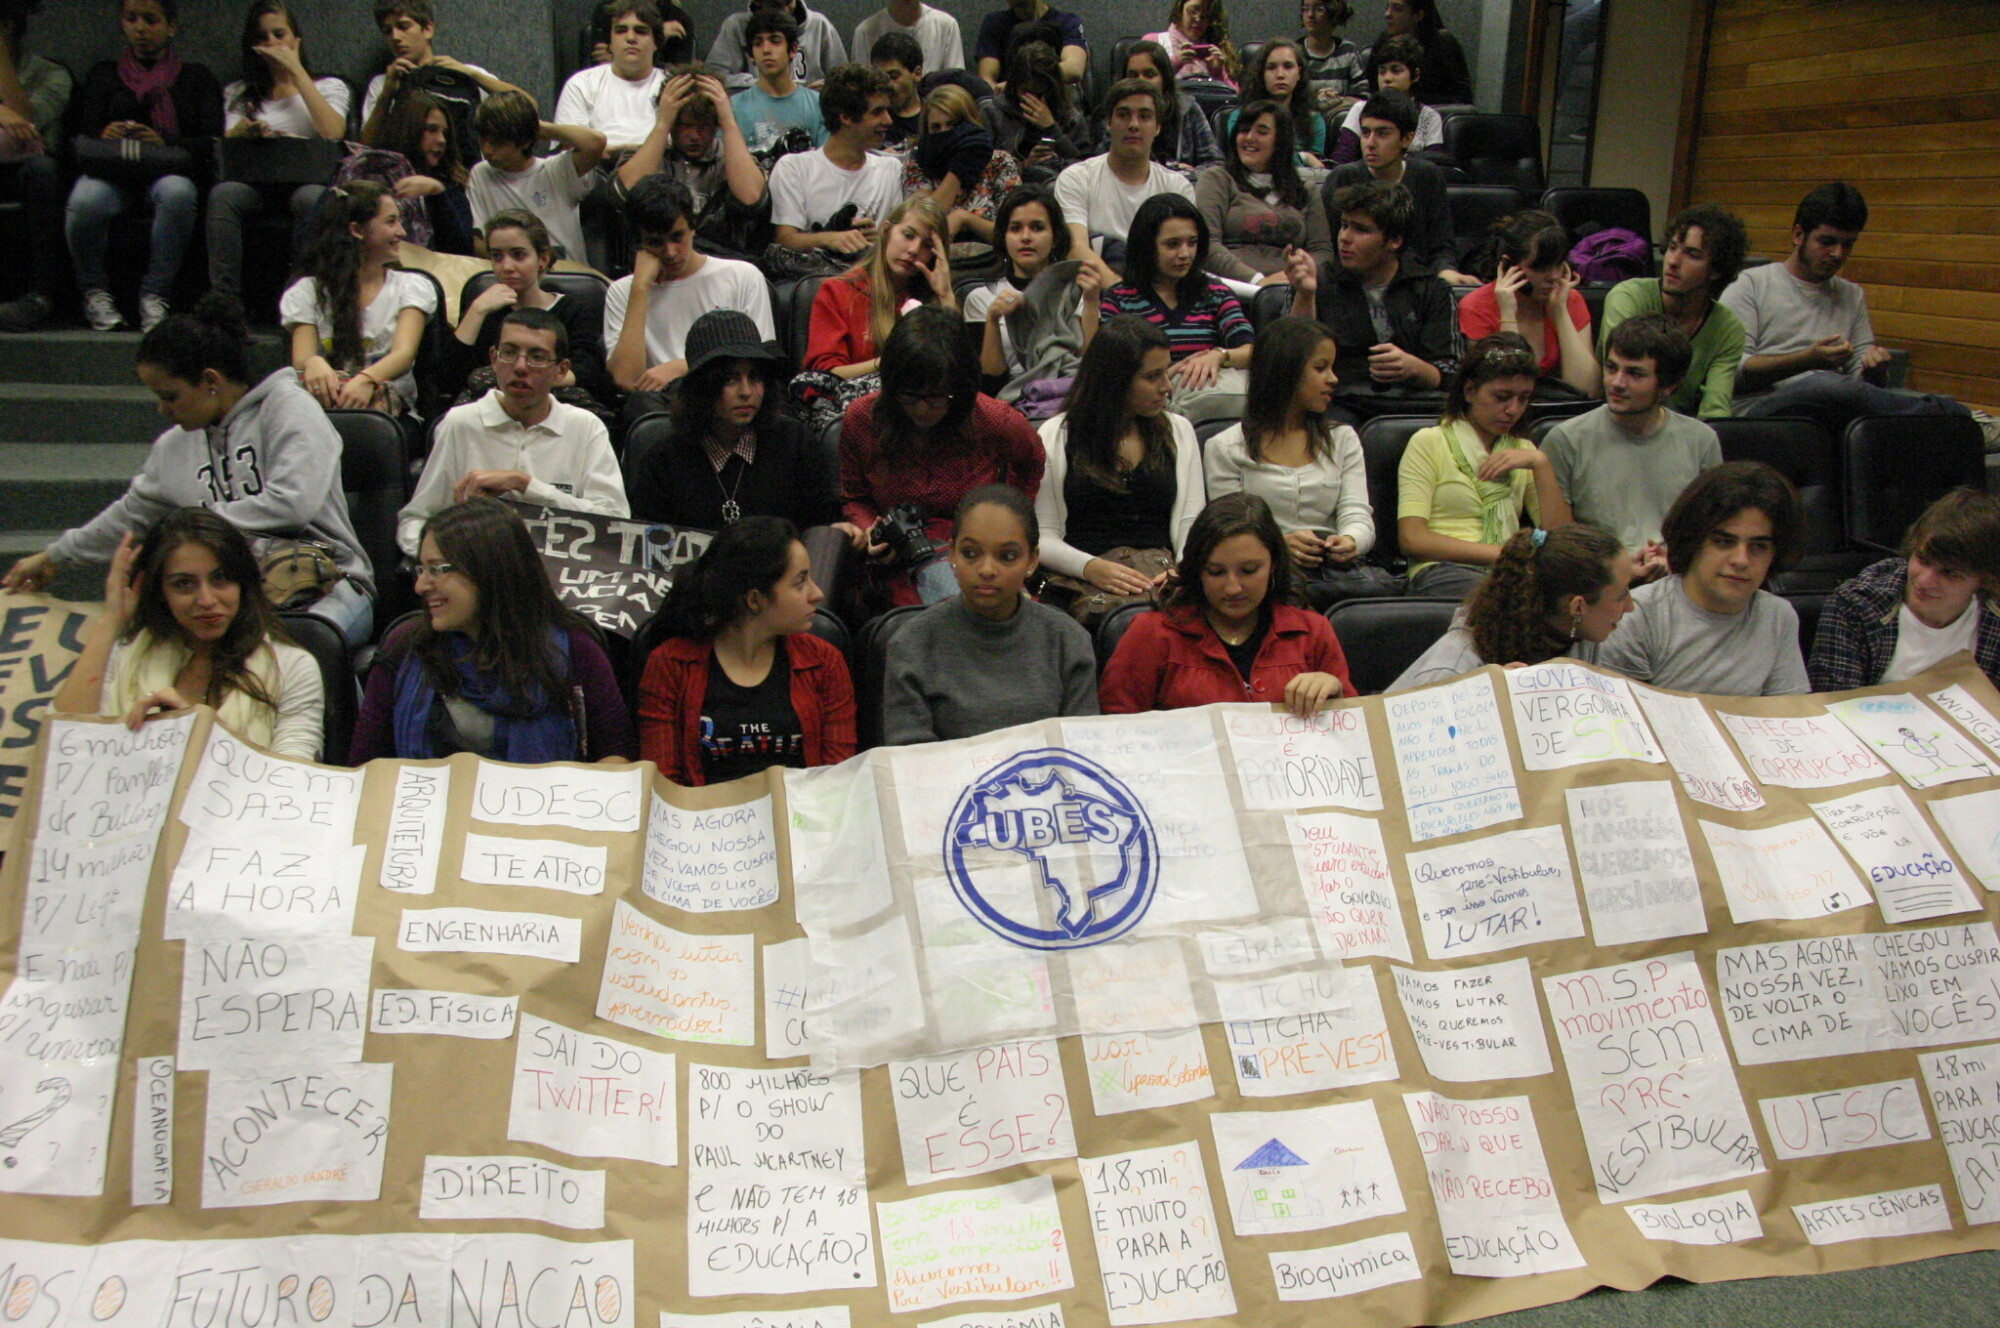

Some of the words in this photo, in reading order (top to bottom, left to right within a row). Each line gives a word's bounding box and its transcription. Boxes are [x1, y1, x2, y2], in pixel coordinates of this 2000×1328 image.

[1518, 668, 1615, 693] GOVERNO
[1520, 694, 1632, 722] VERGONHA
[740, 723, 770, 734] THE
[1725, 716, 1827, 736] CHEGA
[60, 729, 77, 755] 6
[1531, 731, 1566, 755] DE
[1770, 739, 1802, 753] DE
[210, 739, 355, 794] QUEM
[201, 780, 335, 827] SABE
[479, 782, 636, 823] UDESC
[386, 771, 436, 890] ARQUITETURA
[693, 808, 757, 832] AGORA
[985, 801, 1119, 851] UBES
[712, 830, 766, 852] NOSSA
[206, 848, 310, 878] FAZ
[481, 852, 601, 887] TEATRO
[678, 862, 728, 876] VAMOS
[1415, 858, 1494, 883] Queremos
[1871, 853, 1953, 883] EDUCAÇÃO
[175, 881, 195, 911] A
[221, 882, 341, 913] HORA
[664, 877, 701, 893] VOLTA
[711, 880, 720, 891] O
[702, 898, 724, 909] DE
[203, 937, 287, 987] NÃO
[1724, 946, 1788, 977] MAS
[1797, 937, 1858, 968] AGORA
[1872, 929, 1950, 957] CHEGOU
[1963, 926, 1975, 947] A
[26, 954, 46, 982] E
[1398, 974, 1439, 992] VAMOS
[1454, 975, 1492, 989] FAZER
[1725, 971, 1804, 1003] NOSSA
[1879, 956, 1939, 980] VAMOS
[192, 988, 360, 1041] ESPERA
[1402, 991, 1440, 1009] VAMOS
[1456, 994, 1508, 1008] LUTAR
[1559, 981, 1707, 1039] movimento
[1728, 1005, 1757, 1023] DE
[1763, 993, 1821, 1015] VOLTA
[1833, 991, 1846, 1004] O
[1930, 976, 1962, 995] EM
[1439, 1016, 1503, 1030] QUEREMOS
[1817, 1012, 1853, 1033] DE
[591, 1041, 642, 1074] DO
[1597, 1020, 1704, 1075] SEM
[699, 1068, 731, 1090] 800
[900, 1062, 965, 1099] QUE
[1936, 1055, 1958, 1081] 1,8
[1962, 1059, 1986, 1074] mi
[700, 1095, 721, 1120] P/
[736, 1100, 752, 1118] O
[769, 1092, 834, 1118] SHOW
[959, 1094, 981, 1127] É
[1417, 1095, 1449, 1123] NÃO
[1451, 1104, 1519, 1125] POSSO
[1934, 1086, 1982, 1111] PARA
[208, 1076, 388, 1190] ACONTECER
[756, 1122, 784, 1142] DO
[1773, 1087, 1919, 1150] UFSC
[694, 1144, 741, 1169] PAUL
[1418, 1131, 1455, 1154] DAR
[1479, 1135, 1523, 1154] QUE
[240, 1174, 297, 1194] GERALDO
[303, 1162, 349, 1183] VANDRÉ
[1093, 1159, 1131, 1195] 1,8
[1137, 1160, 1167, 1187] mi
[1432, 1169, 1465, 1201] NÃO
[1467, 1175, 1550, 1199] RECEBO
[730, 1184, 771, 1211] NÃO
[781, 1185, 827, 1204] TEM
[837, 1187, 859, 1207] 1,8
[1801, 1204, 1865, 1235] ARTES
[1869, 1189, 1940, 1218] CÊNICAS
[773, 1208, 791, 1237] P/
[805, 1209, 818, 1228] A
[1095, 1202, 1109, 1231] É
[1116, 1231, 1170, 1260] PARA
[1180, 1228, 1192, 1250] A
[1446, 1226, 1558, 1263] EDUCAÇÃO
[91, 1275, 127, 1321] O
[167, 1266, 335, 1328] FUTURO
[352, 1273, 422, 1328] DA
[1104, 1254, 1226, 1310] EDUCAÇÃO
